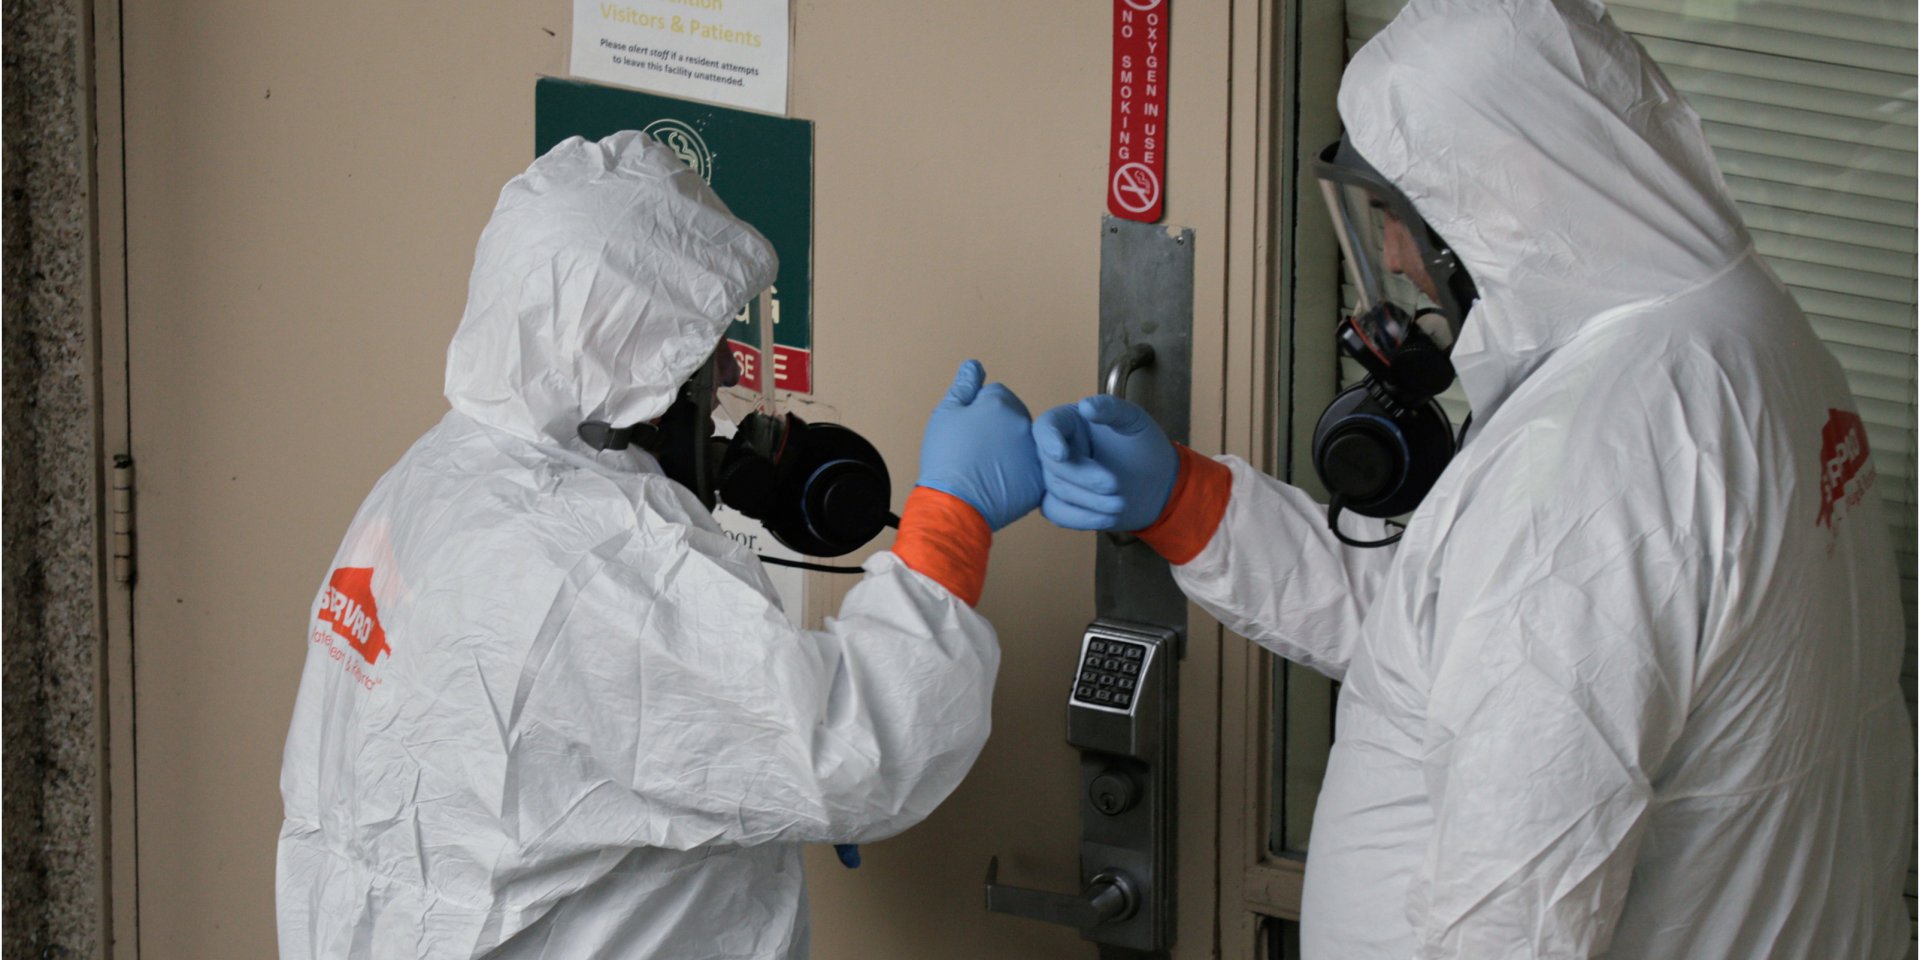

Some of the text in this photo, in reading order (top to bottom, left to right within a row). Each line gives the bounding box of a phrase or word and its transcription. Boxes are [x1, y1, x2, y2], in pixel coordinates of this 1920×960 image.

[600, 2, 762, 47] Visitors & Patients
[600, 38, 626, 51] Please
[628, 43, 648, 55] alert
[650, 48, 670, 60] staff
[671, 51, 677, 60] if
[685, 56, 720, 69] resident
[720, 62, 759, 76] attempts
[613, 55, 745, 87] to leave this facility unattended.
[1118, 10, 1133, 160] NO SMOKING
[1144, 13, 1159, 164] OXYGEN IN USE
